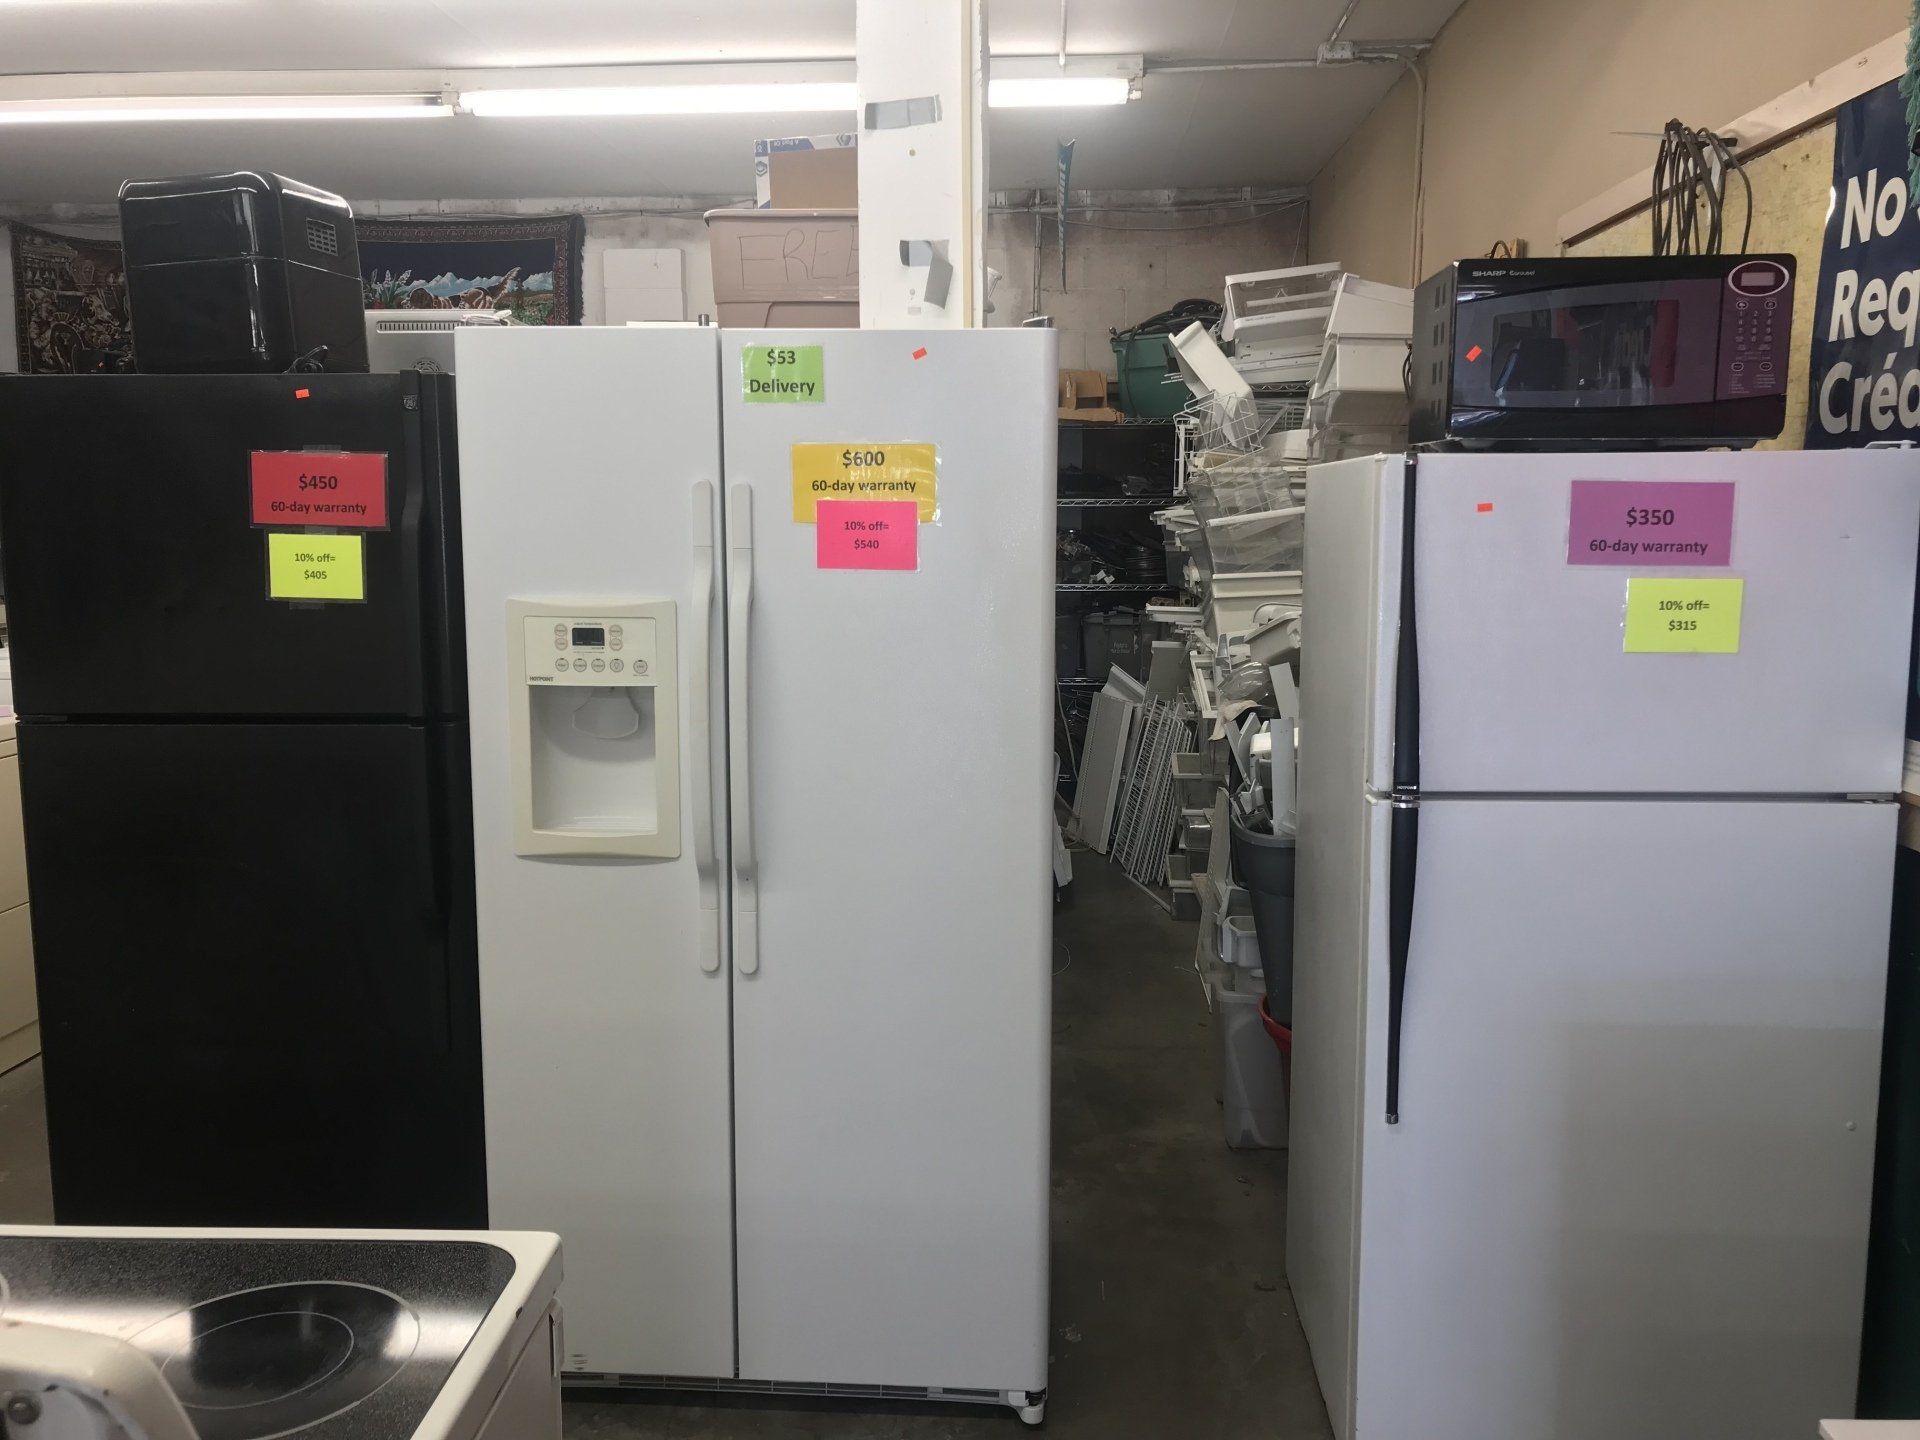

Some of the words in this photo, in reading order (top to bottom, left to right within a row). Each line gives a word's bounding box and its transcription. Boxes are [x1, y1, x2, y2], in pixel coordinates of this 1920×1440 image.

[1840, 168, 1907, 249] No
[1472, 269, 1507, 277] SHARP
[1828, 268, 1920, 348] Req
[767, 349, 796, 366] $53
[750, 379, 815, 396] Delivery
[842, 449, 885, 468] $600
[299, 474, 338, 491] $450
[811, 480, 855, 493] 60-day
[859, 480, 916, 493] warranty
[271, 501, 311, 514] 60-day
[314, 503, 367, 515] warranty
[1626, 507, 1674, 527] $350
[844, 521, 866, 531] 10%
[868, 521, 889, 531] off=
[854, 539, 880, 550] $540
[1589, 539, 1639, 554] 60-day
[1643, 541, 1708, 556] warranty
[295, 553, 315, 562] 10%
[317, 553, 336, 563] off=
[304, 570, 327, 580] $405
[1658, 600, 1683, 611] 10%
[1686, 600, 1710, 611] off=
[1668, 620, 1697, 632] $315
